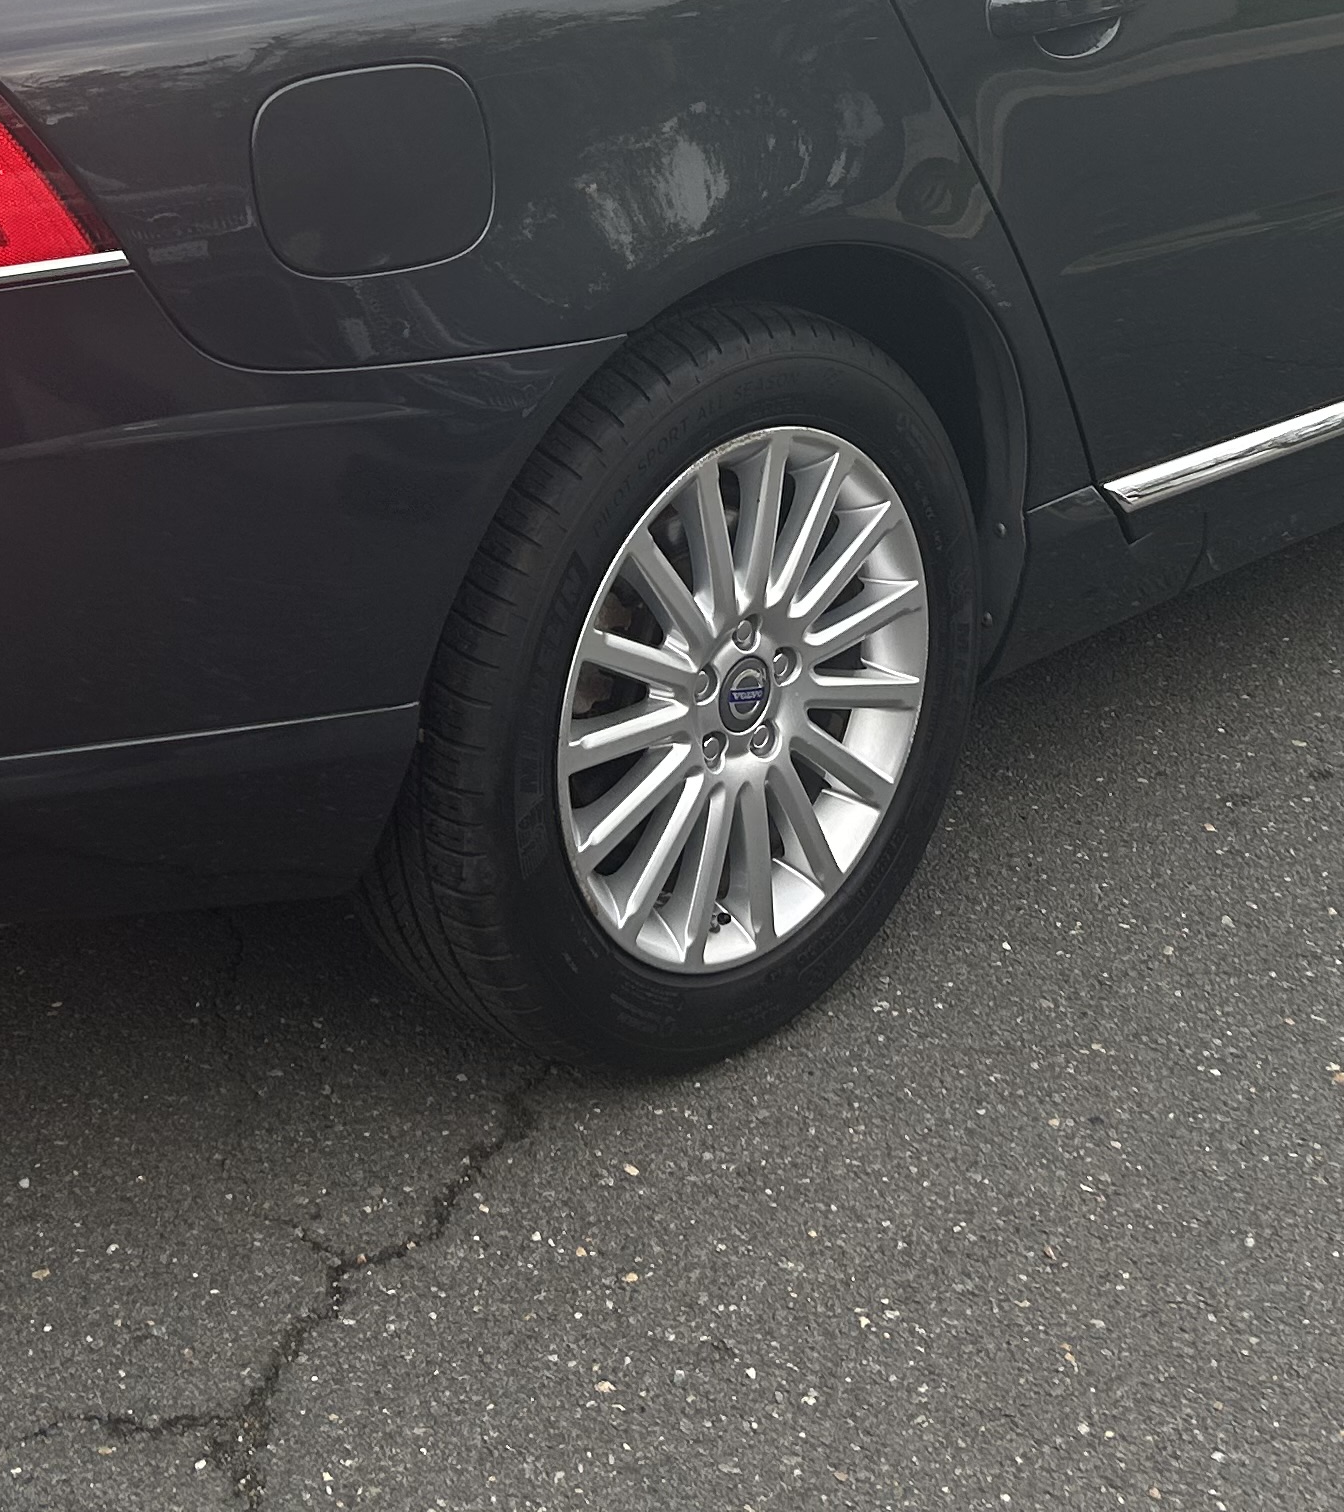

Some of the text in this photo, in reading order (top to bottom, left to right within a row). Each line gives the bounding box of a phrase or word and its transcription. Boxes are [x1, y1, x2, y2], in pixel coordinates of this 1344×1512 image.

[637, 416, 689, 473] SPORT
[697, 397, 724, 424] ALL
[731, 690, 763, 700] VOLVO
